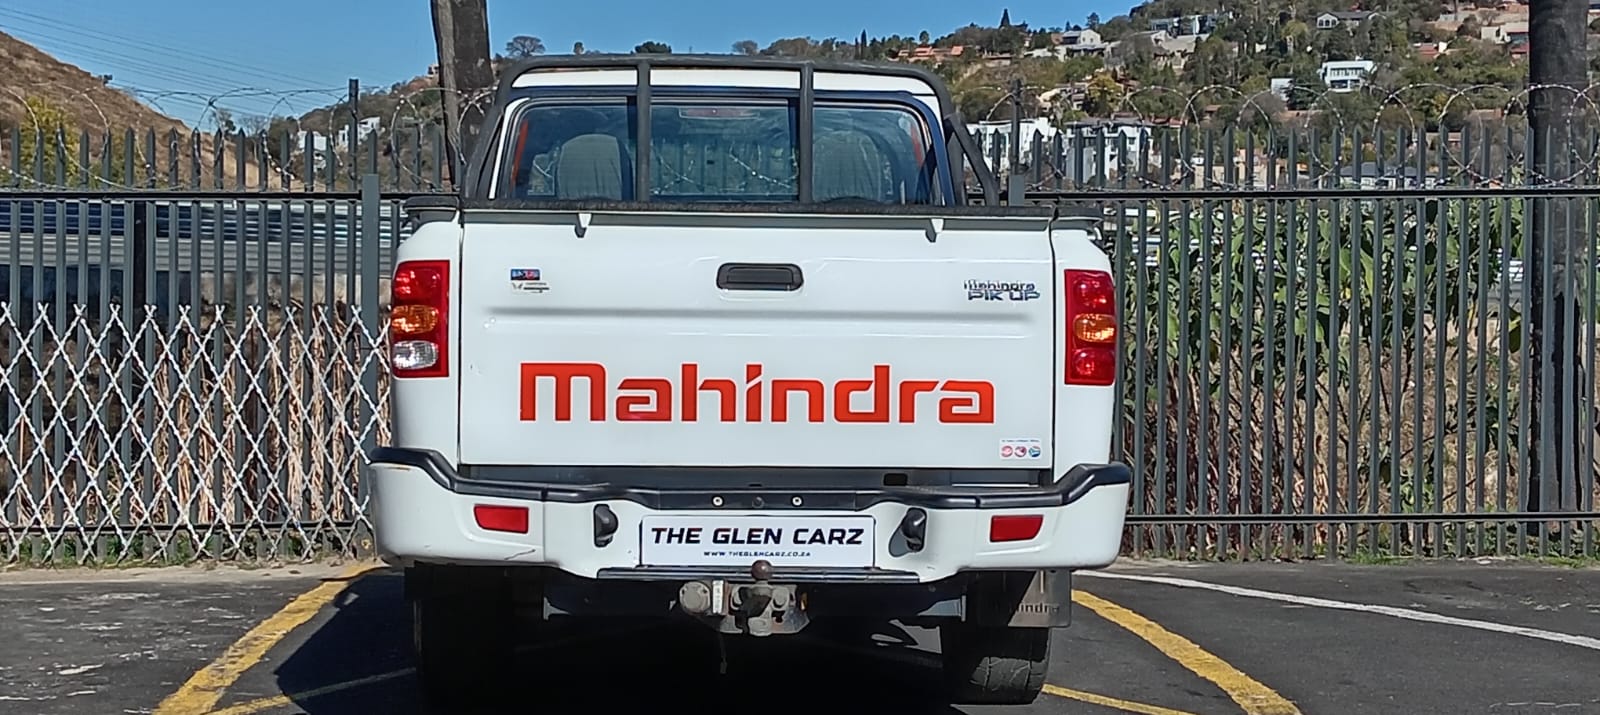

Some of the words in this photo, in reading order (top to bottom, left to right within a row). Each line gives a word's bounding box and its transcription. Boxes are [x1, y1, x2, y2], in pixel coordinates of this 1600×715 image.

[1009, 290, 1041, 301] UP
[520, 362, 995, 424] Mahindra
[651, 527, 703, 545] THE
[712, 528, 783, 545] GLEN
[793, 528, 865, 545] CARZ
